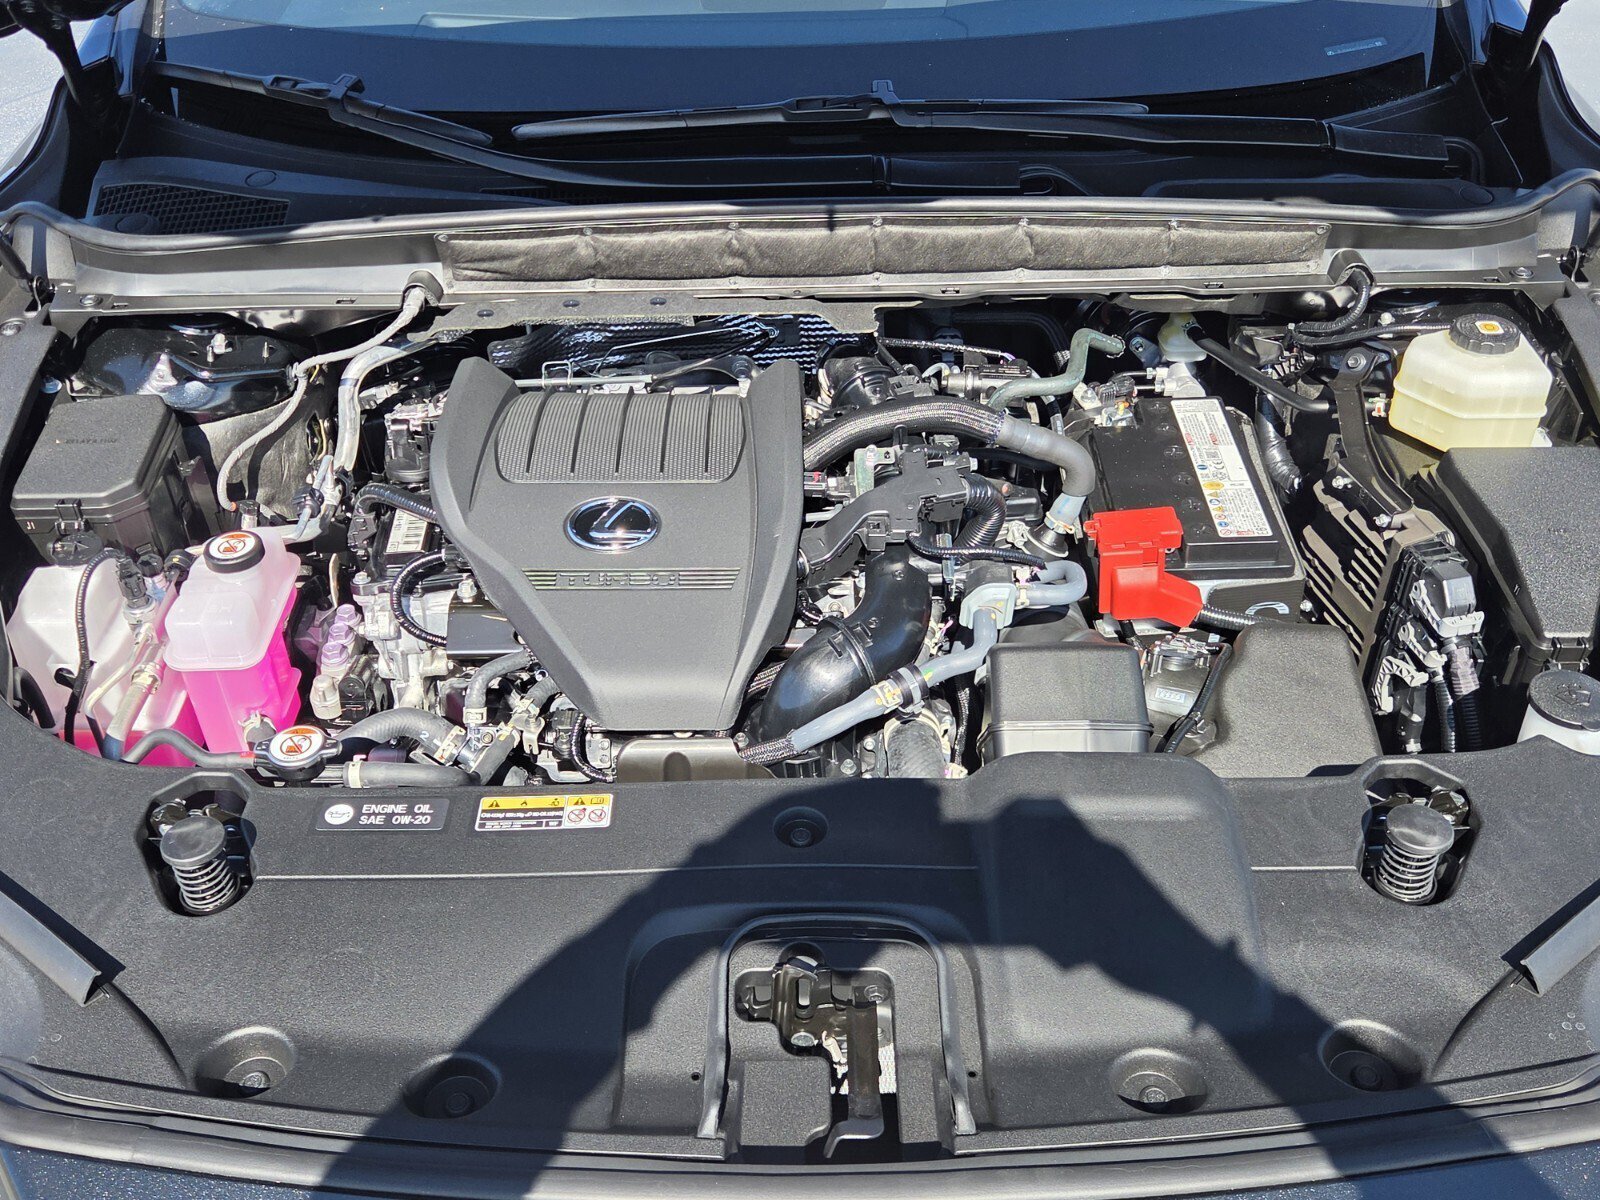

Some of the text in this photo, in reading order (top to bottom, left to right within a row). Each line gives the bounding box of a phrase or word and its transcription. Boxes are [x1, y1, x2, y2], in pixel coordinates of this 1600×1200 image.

[559, 571, 677, 586] TURBO
[362, 804, 434, 814] ENGINE OIL
[358, 815, 431, 825] SAE 0W-20
